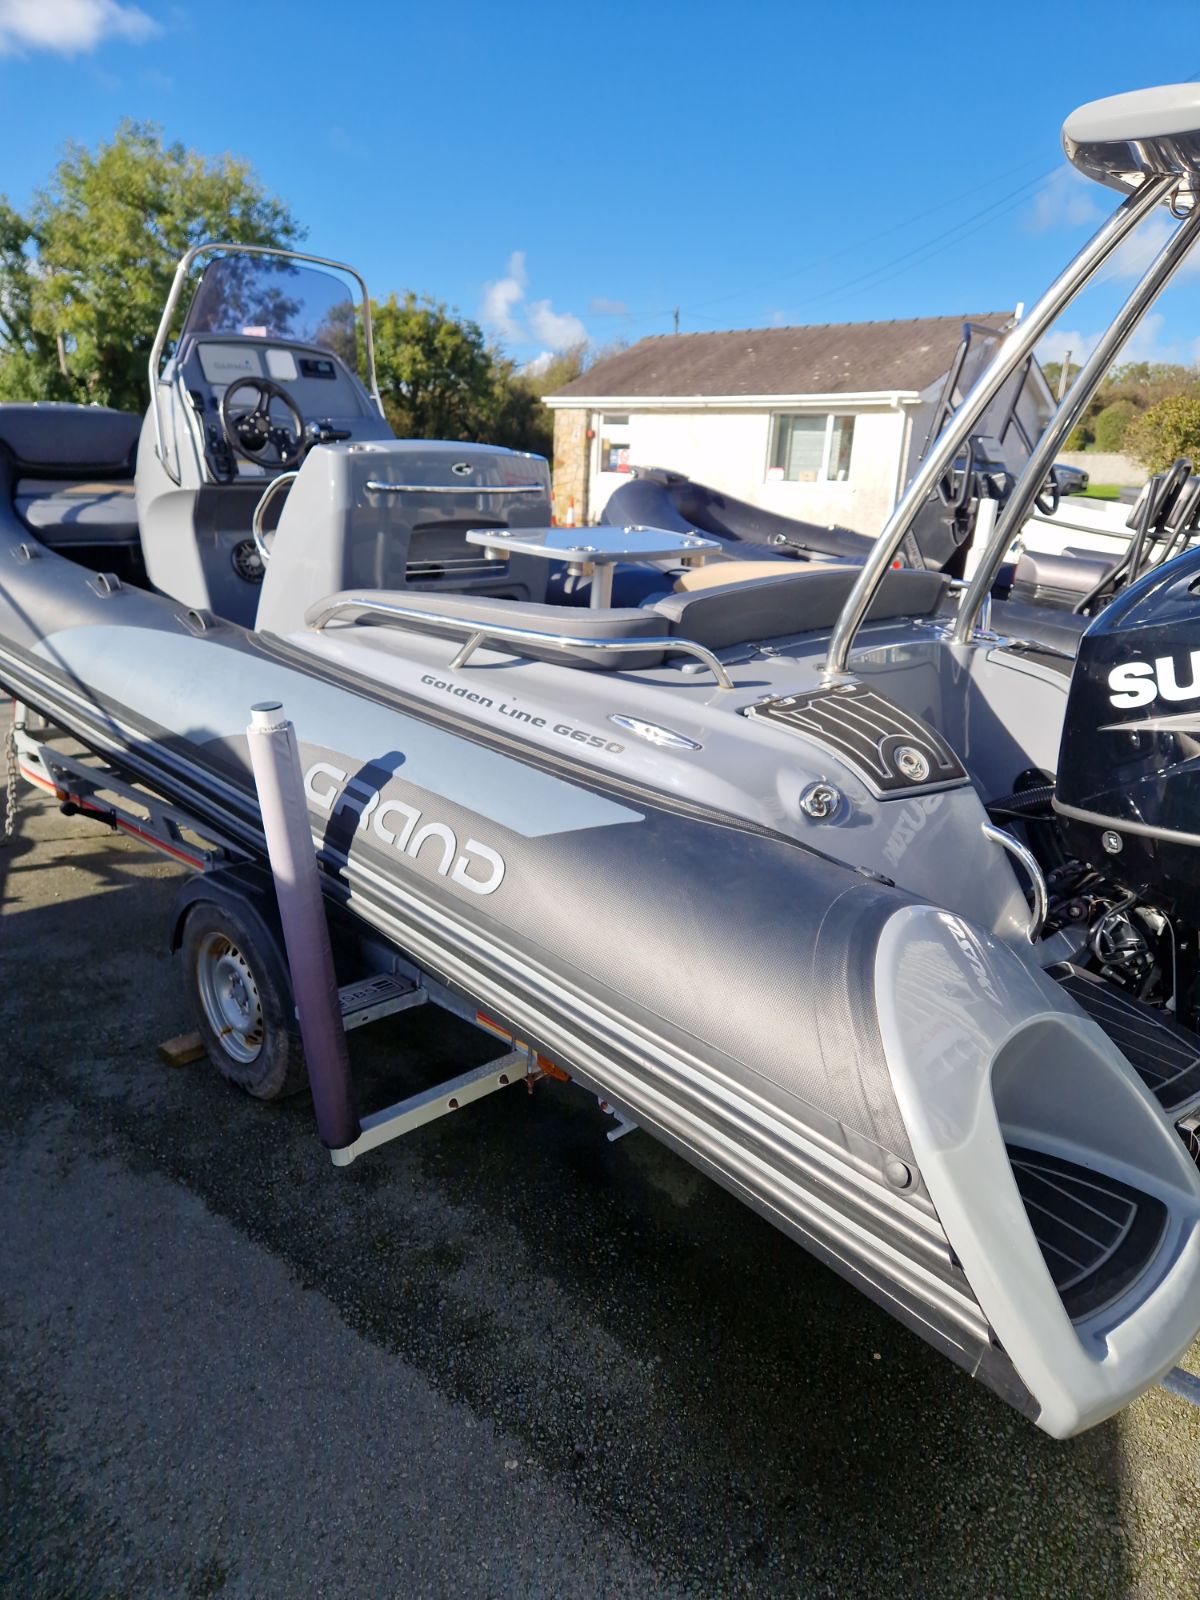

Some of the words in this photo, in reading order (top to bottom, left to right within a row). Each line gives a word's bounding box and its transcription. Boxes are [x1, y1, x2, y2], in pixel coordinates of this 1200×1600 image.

[420, 673, 494, 708] Golden
[498, 702, 547, 728] Line
[552, 723, 627, 755] G650
